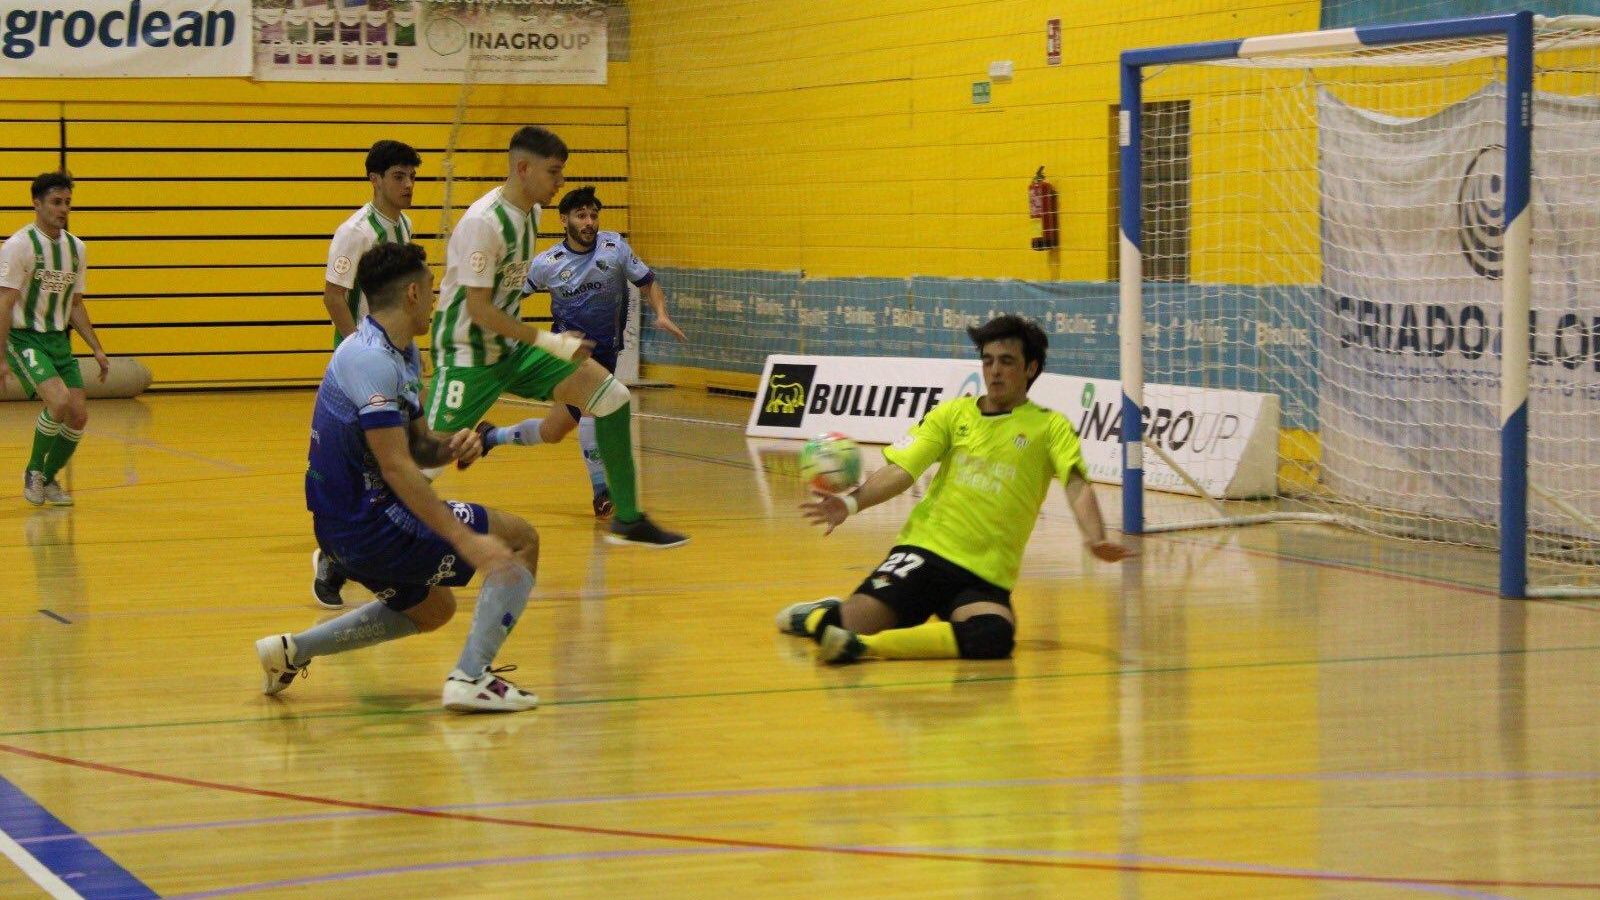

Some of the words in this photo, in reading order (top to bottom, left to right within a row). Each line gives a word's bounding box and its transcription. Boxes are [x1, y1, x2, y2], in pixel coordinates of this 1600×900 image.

[469, 32, 590, 50] INAGROUP
[1527, 309, 1600, 374] LO
[445, 380, 465, 409] 8
[879, 552, 925, 578] 27
